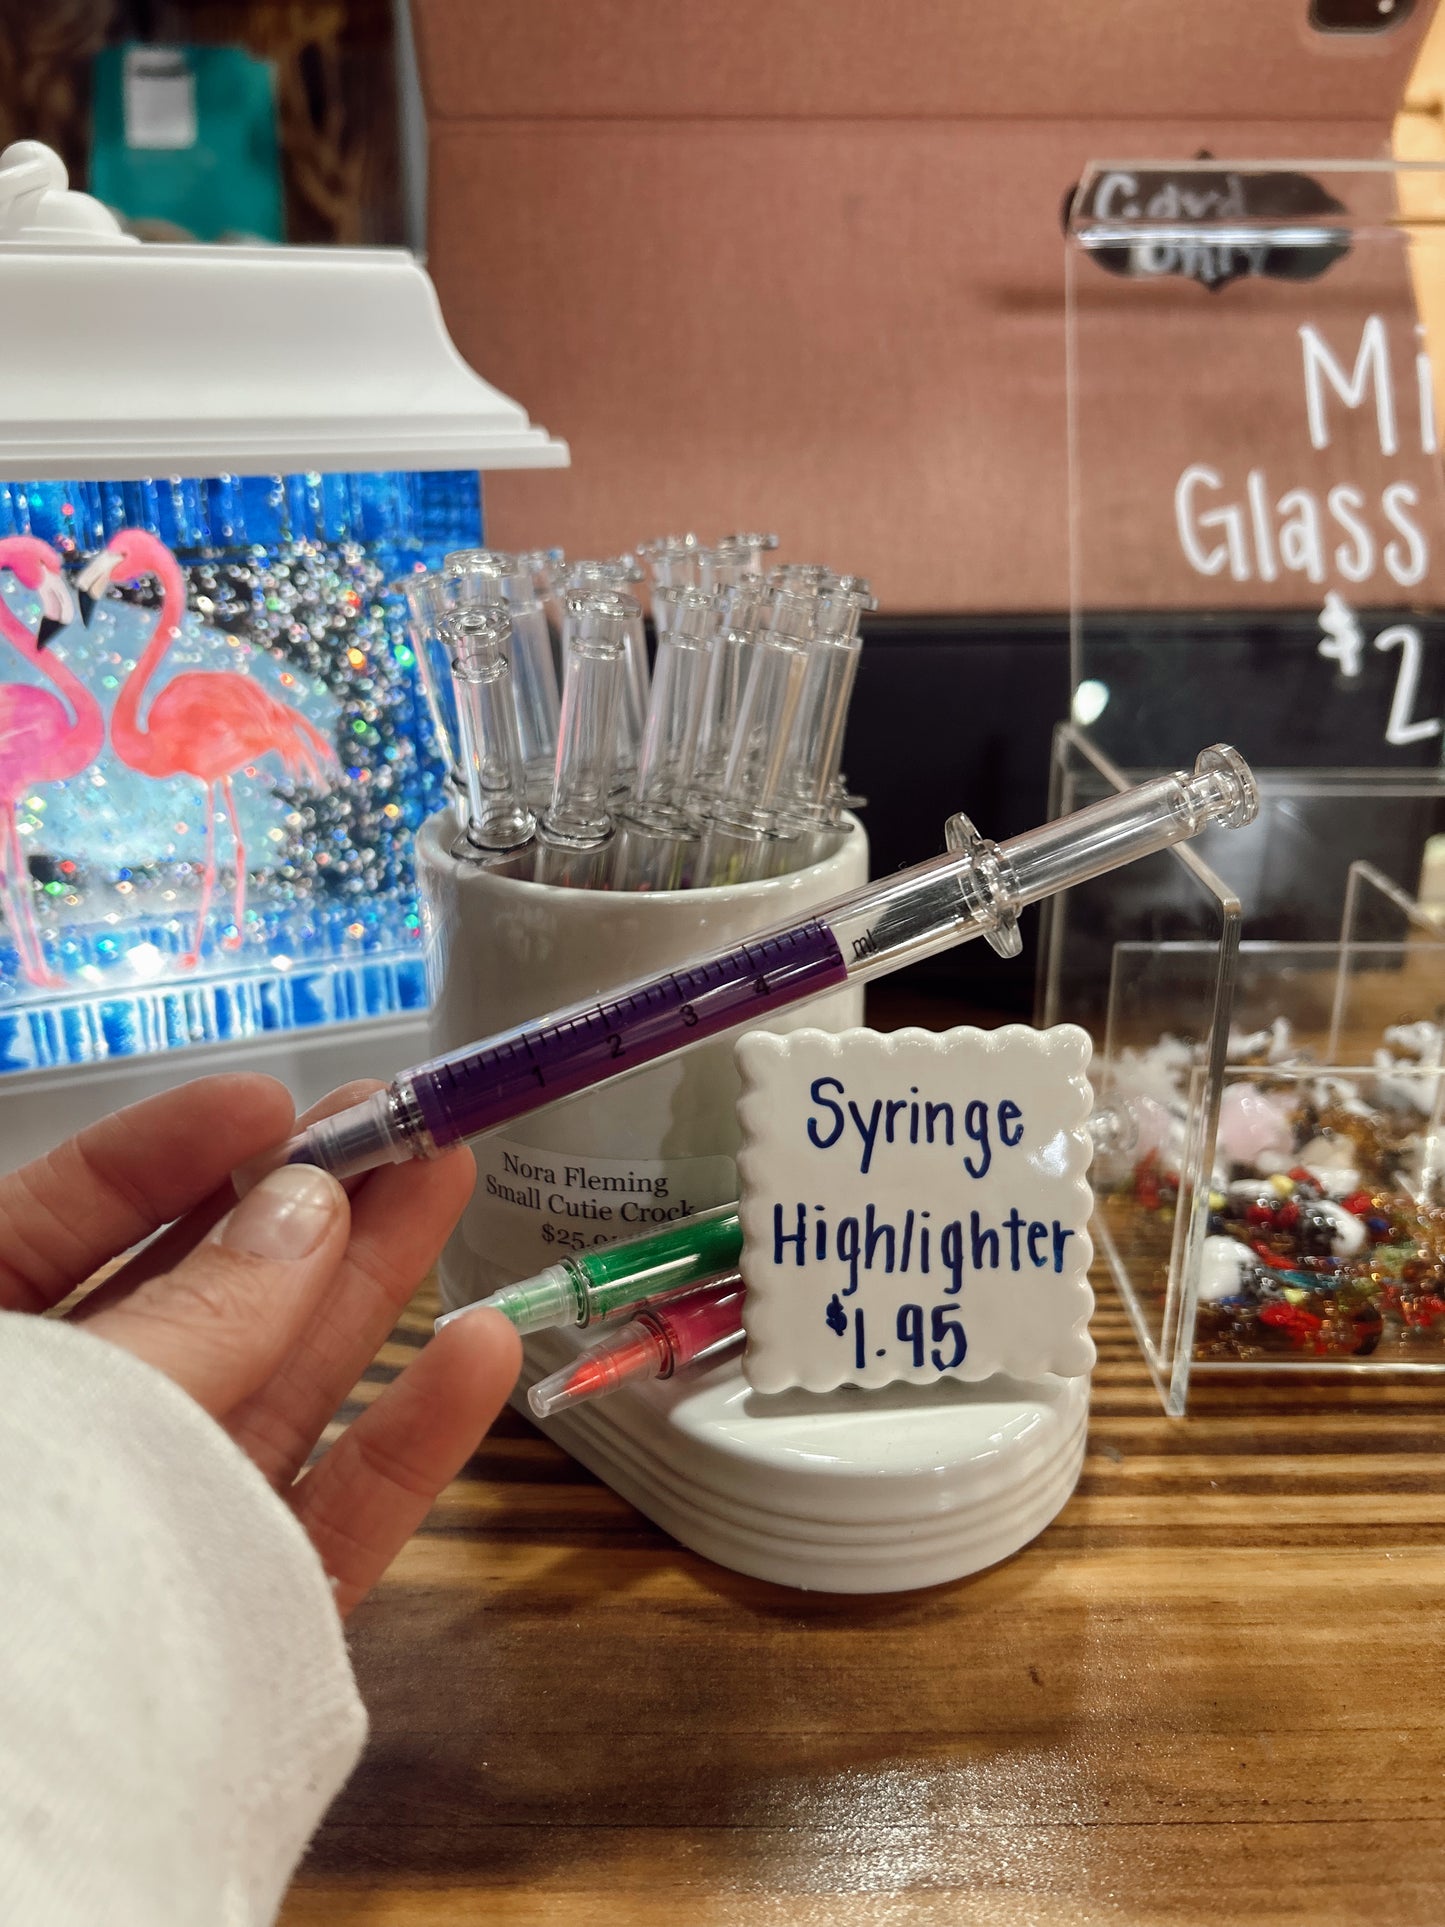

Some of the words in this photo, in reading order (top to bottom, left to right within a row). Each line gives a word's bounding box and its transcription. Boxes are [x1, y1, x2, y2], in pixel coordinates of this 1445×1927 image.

[1174, 463, 1428, 586] Glass
[530, 1064, 546, 1089] 1
[606, 1032, 626, 1060] 2
[679, 1003, 700, 1028] 3
[753, 974, 772, 997] 4
[851, 928, 878, 960] ml
[502, 1151, 556, 1185] Nora
[564, 1166, 669, 1197] Fleming
[806, 1076, 1024, 1179] Syringe
[485, 1174, 541, 1211] Small
[547, 1194, 613, 1222] Cutie
[620, 1200, 696, 1223] Crock
[773, 1203, 1075, 1296] Highlighter
[825, 1294, 968, 1371] $1.95
